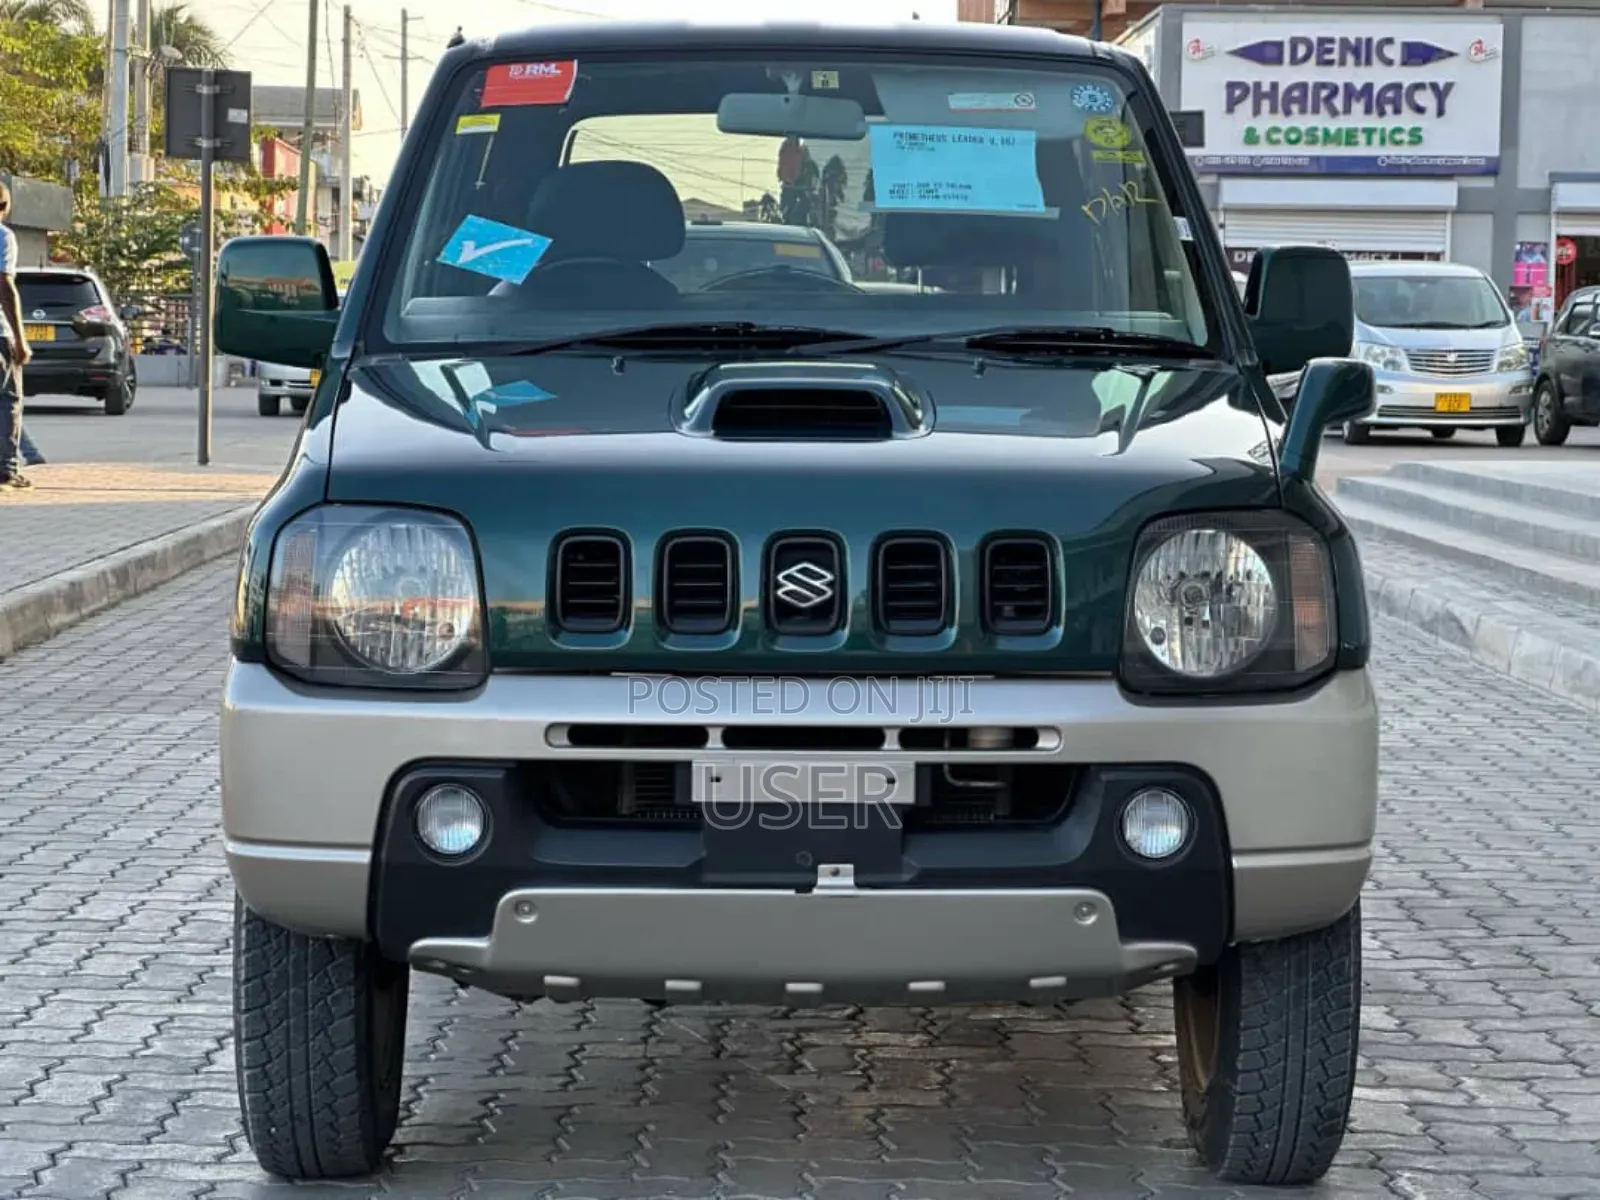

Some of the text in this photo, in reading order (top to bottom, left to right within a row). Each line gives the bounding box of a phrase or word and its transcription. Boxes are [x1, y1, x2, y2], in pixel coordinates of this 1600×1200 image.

[1289, 36, 1395, 67] DENIC
[1225, 81, 1455, 117] PHARMACY
[1243, 126, 1423, 146] & COSMETICS
